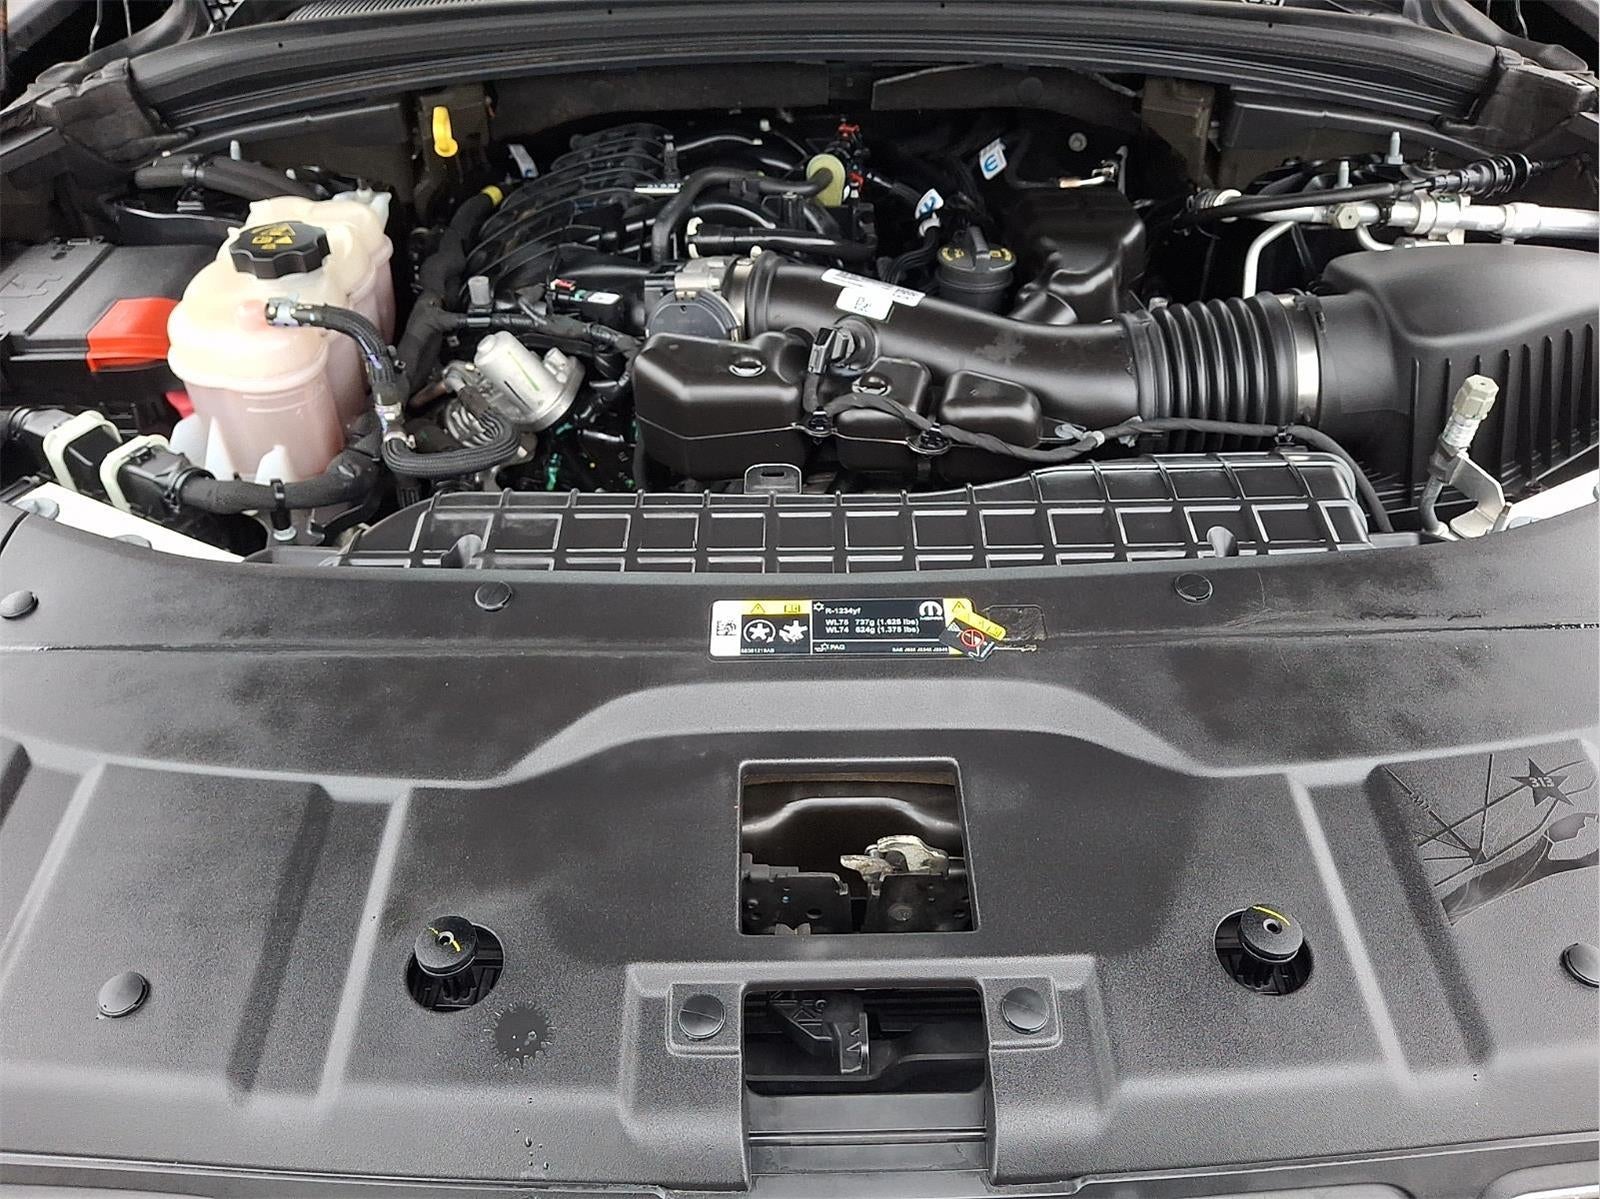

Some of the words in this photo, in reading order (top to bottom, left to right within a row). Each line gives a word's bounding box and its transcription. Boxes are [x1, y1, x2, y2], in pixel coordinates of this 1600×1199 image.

[825, 607, 861, 616] R-1234yf
[855, 619, 875, 627] 737g
[903, 619, 919, 627] lbs)
[825, 626, 849, 634] WL74
[855, 626, 876, 635] 624g
[903, 626, 920, 635] lbs)
[1529, 776, 1555, 788] 313
